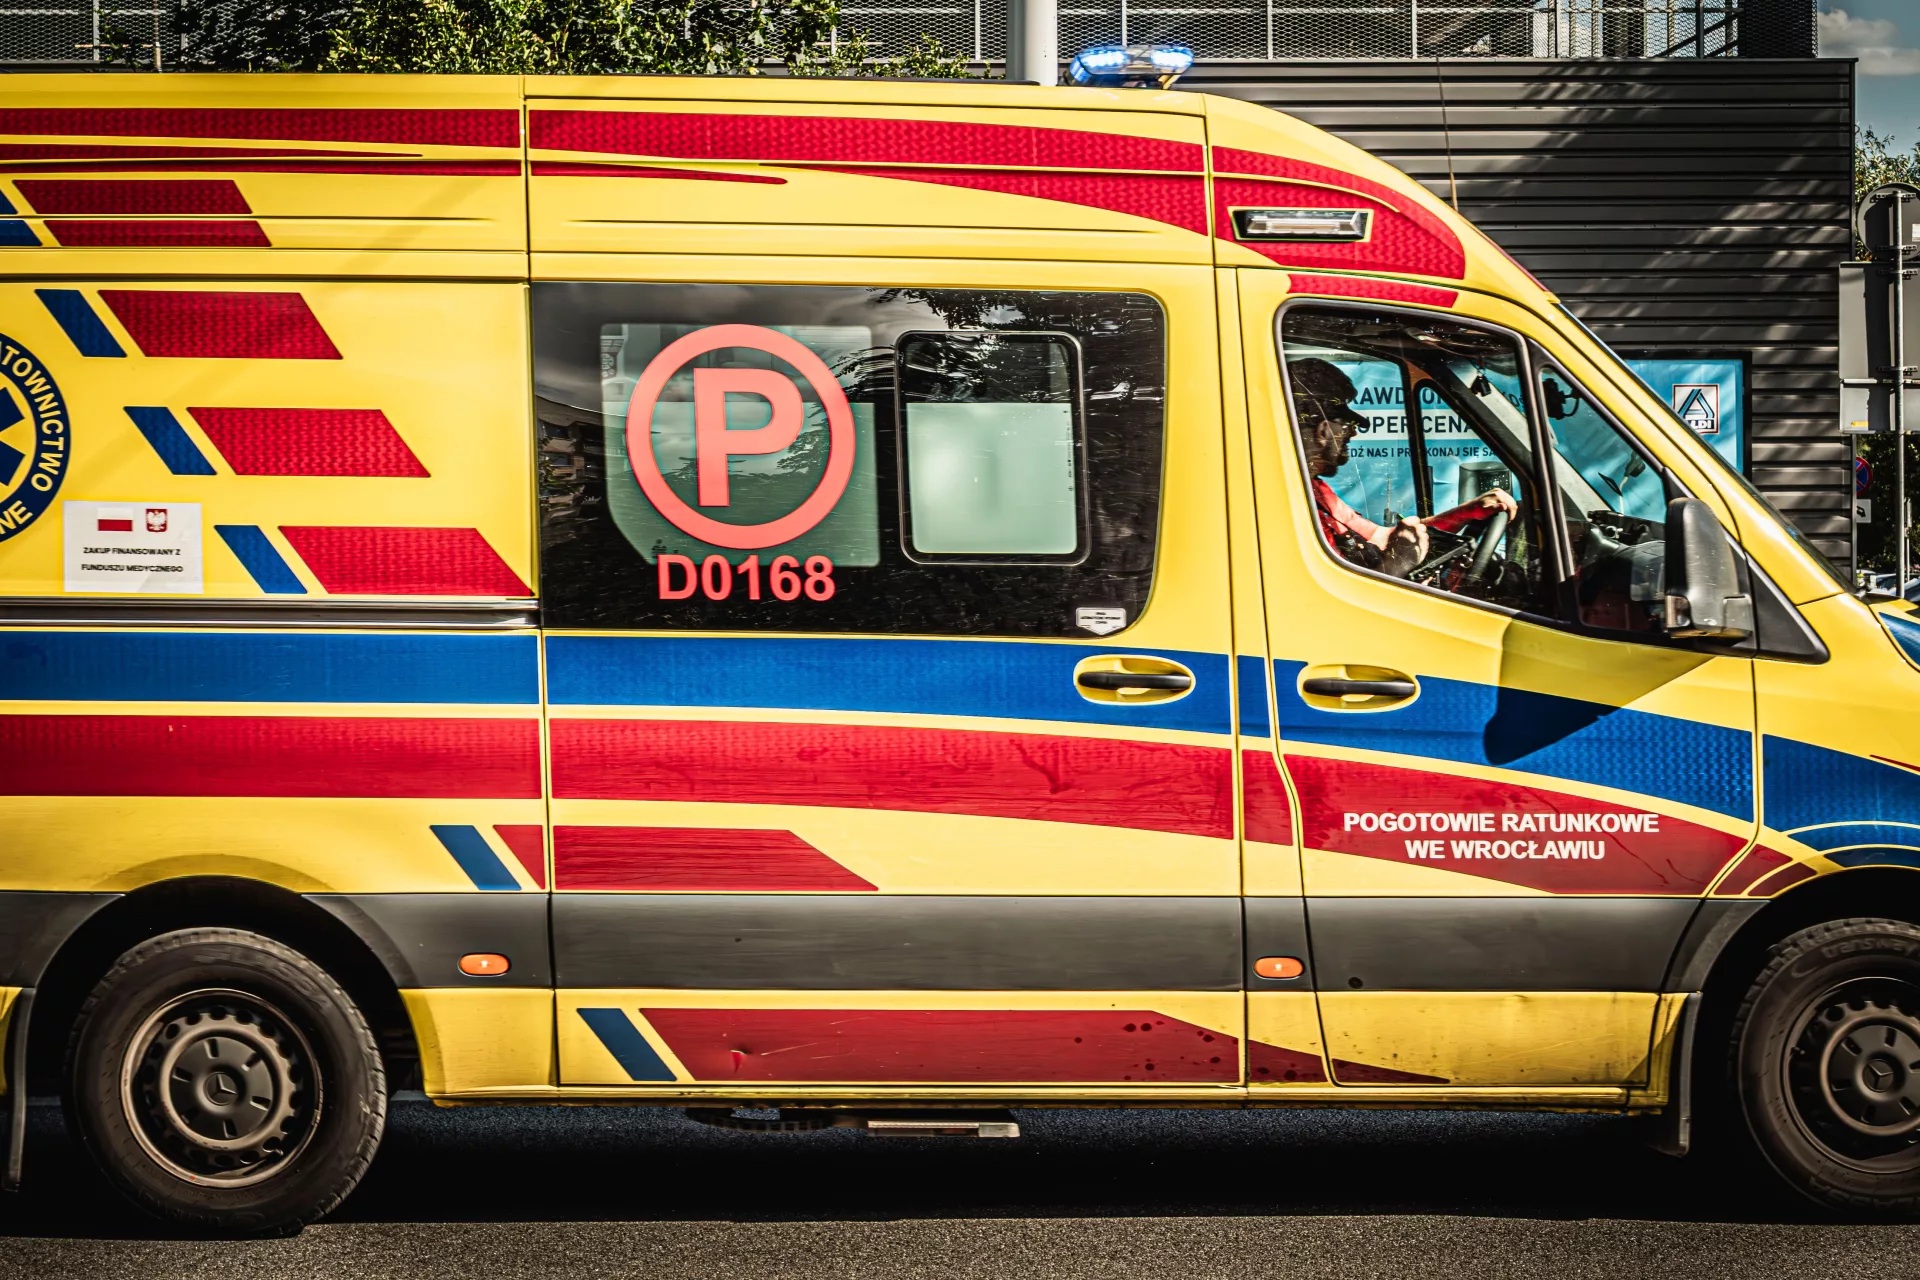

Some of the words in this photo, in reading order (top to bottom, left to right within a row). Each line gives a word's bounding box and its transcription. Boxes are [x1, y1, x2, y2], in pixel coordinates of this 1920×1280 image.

[0, 341, 64, 492] TOWNICTWO
[693, 367, 804, 507] P
[1367, 448, 1388, 458] NAS
[1463, 447, 1480, 459] SIĘ
[1482, 447, 1498, 457] SA
[83, 547, 111, 555] ZAKUP
[1344, 812, 1496, 832] POGOTOWIE
[1502, 813, 1660, 833] RATUNKOWE
[1405, 840, 1445, 859] WE
[1451, 840, 1605, 860] WROCŁAWIU
